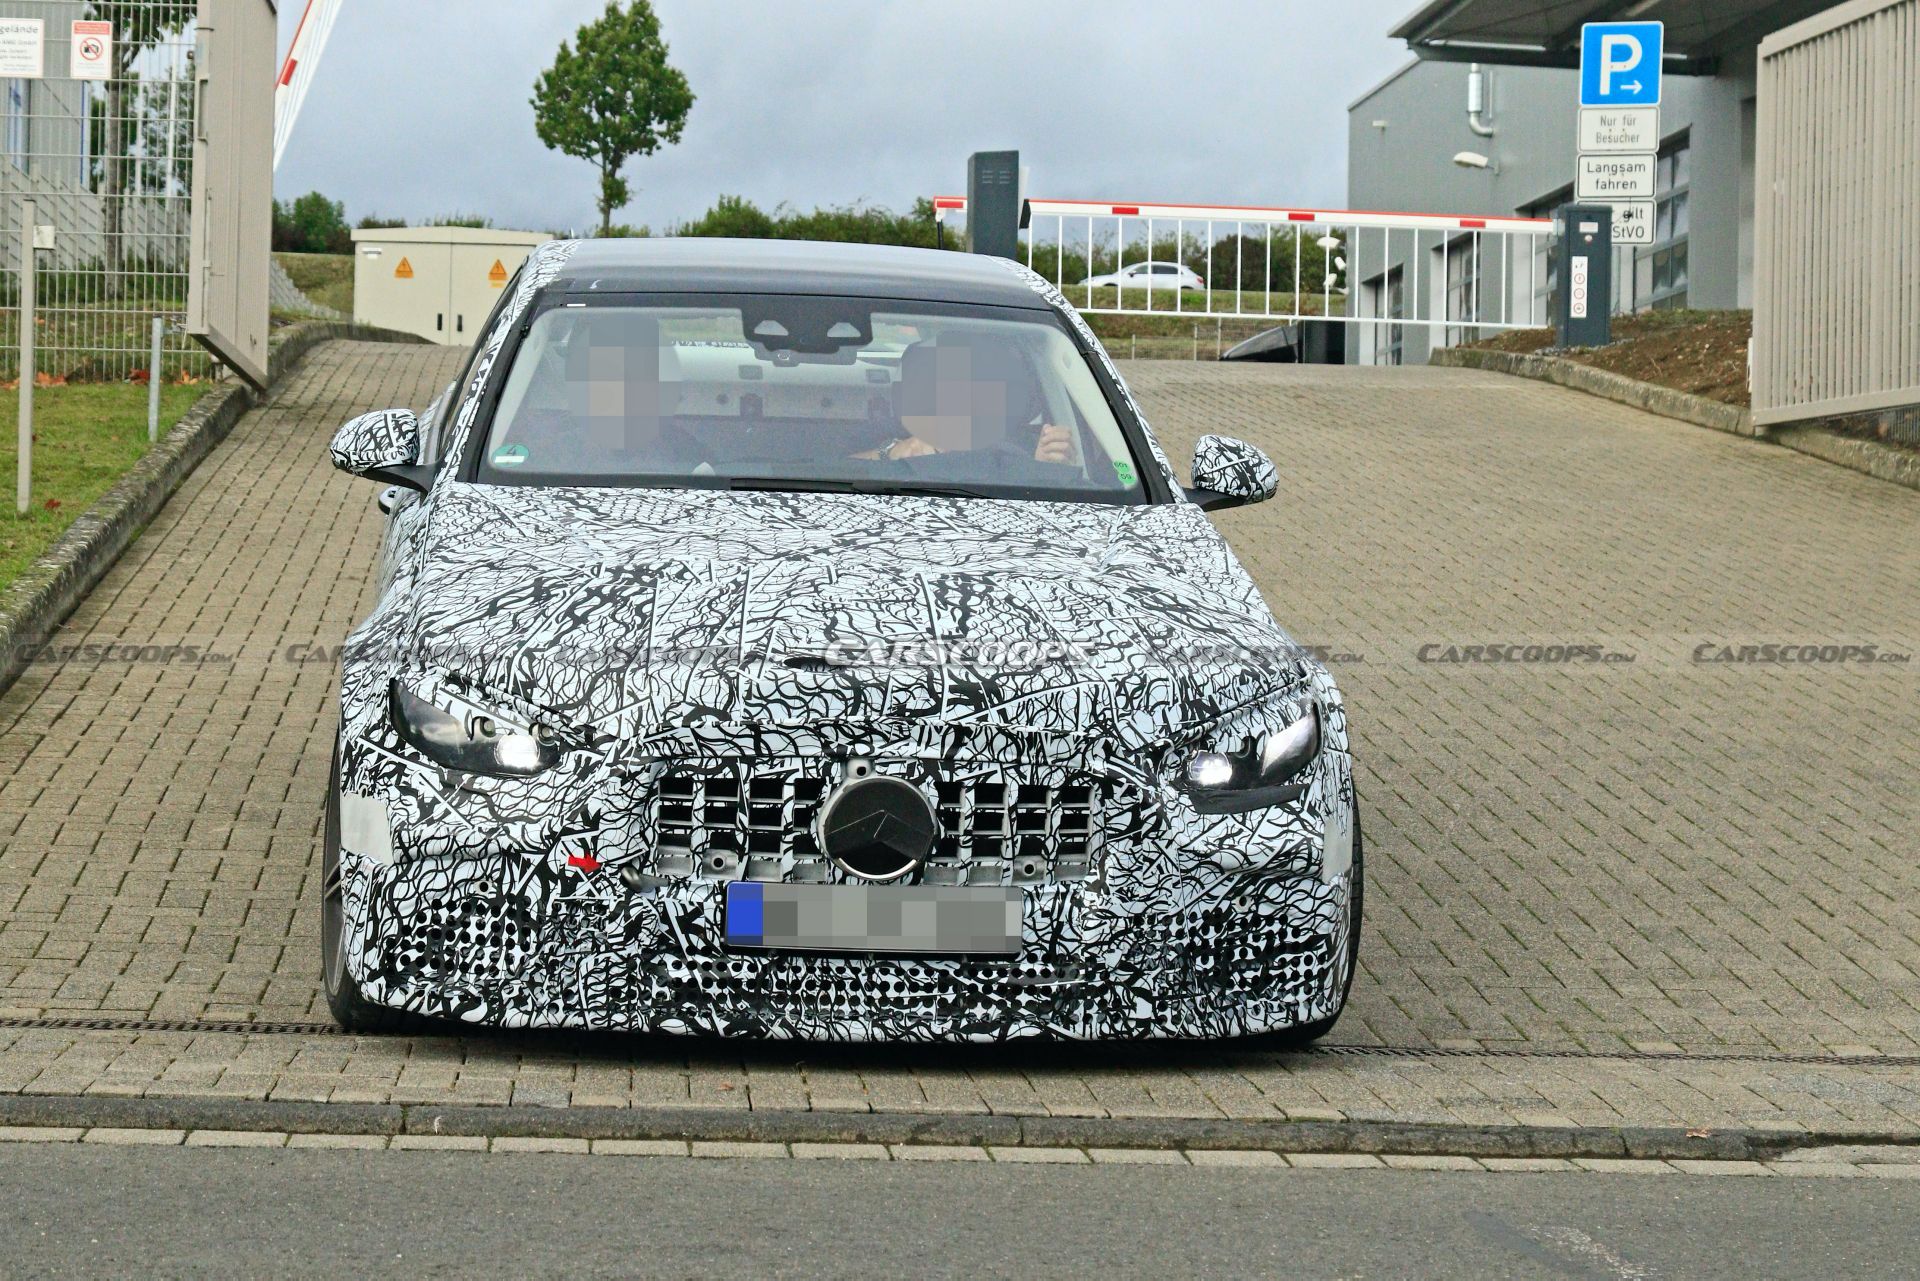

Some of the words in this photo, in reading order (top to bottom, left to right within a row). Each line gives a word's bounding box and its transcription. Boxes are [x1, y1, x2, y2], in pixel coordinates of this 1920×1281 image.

[1600, 34, 1642, 95] P
[1600, 115, 1616, 126] Nur
[1622, 114, 1636, 126] für
[1596, 132, 1640, 144] Besucher
[1587, 161, 1646, 176] Langsam
[1596, 178, 1637, 190] fahren
[1623, 206, 1643, 222] gilt
[1612, 225, 1645, 238] StVO
